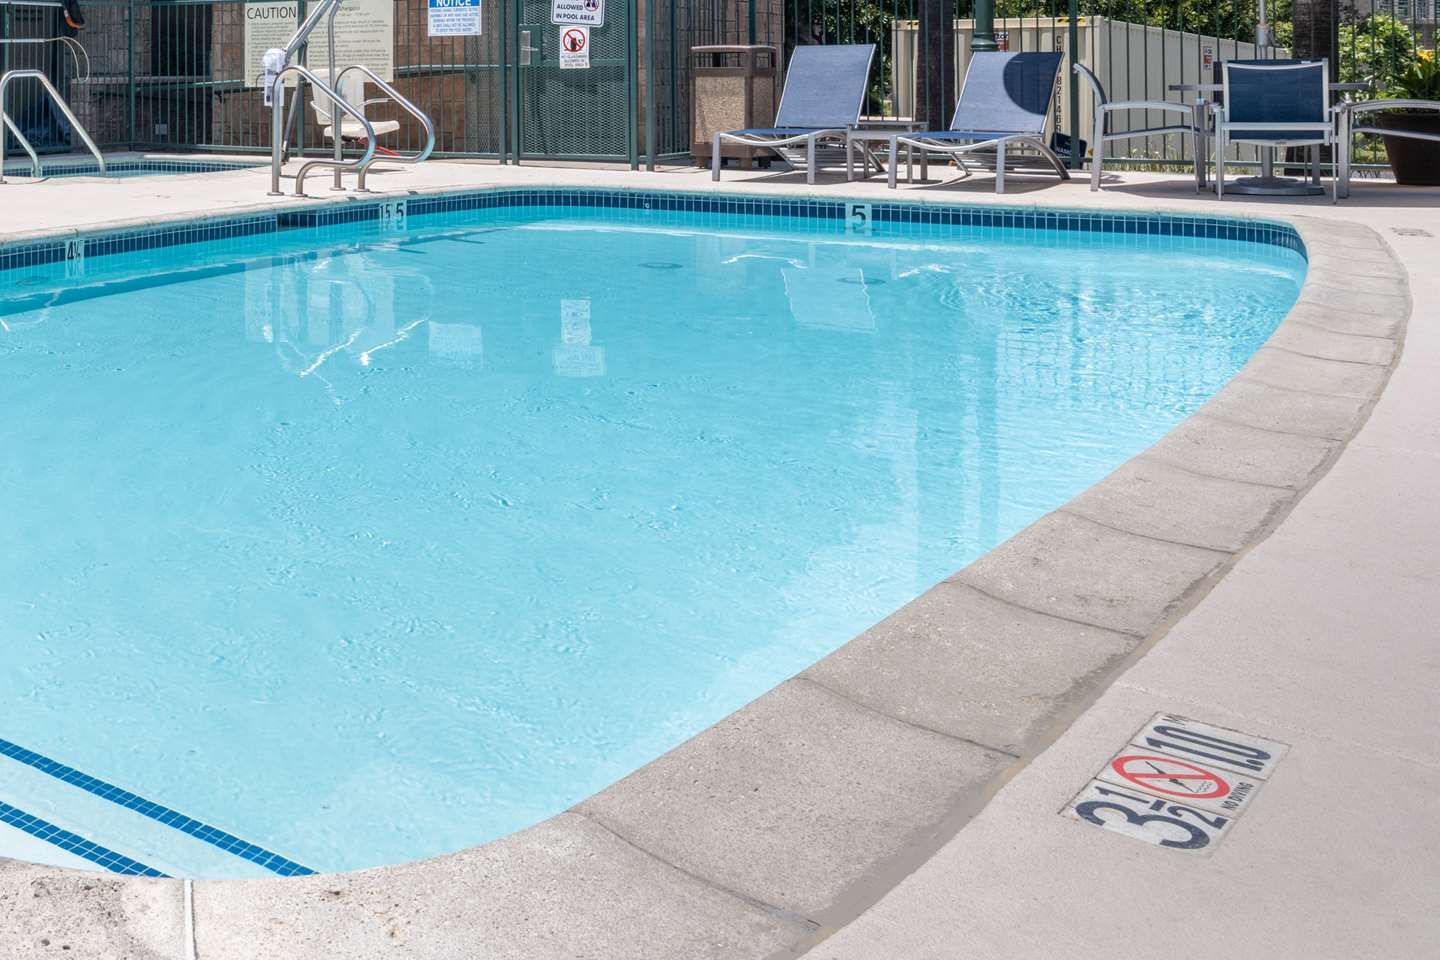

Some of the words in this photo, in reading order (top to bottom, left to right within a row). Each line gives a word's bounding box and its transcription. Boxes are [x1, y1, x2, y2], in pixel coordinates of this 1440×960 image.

[246, 6, 298, 20] CAUTION
[556, 3, 584, 11] ALLOWED
[851, 204, 867, 222] 5
[1228, 781, 1255, 803] DIVING
[1220, 800, 1240, 811] NO
